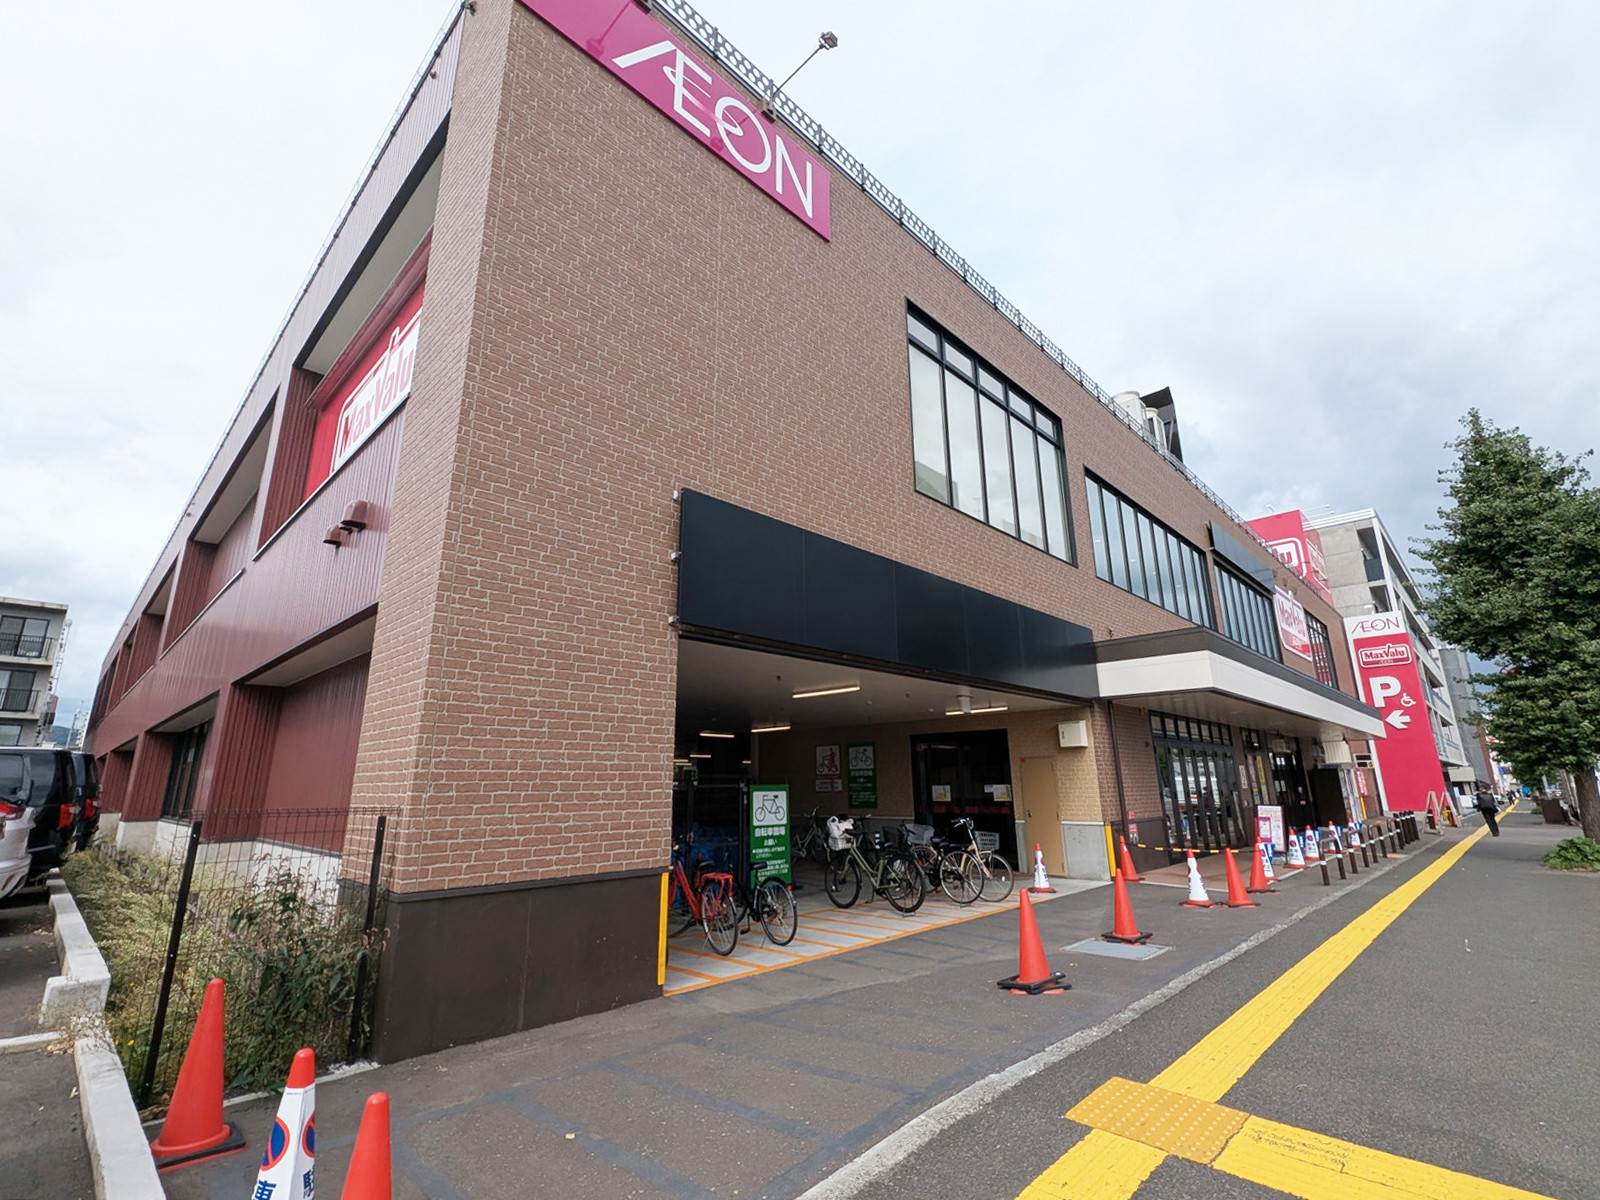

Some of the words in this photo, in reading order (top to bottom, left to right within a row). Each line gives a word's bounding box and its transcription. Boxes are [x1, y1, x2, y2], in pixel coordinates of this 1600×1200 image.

[339, 335, 415, 459] MaxValu
[1364, 645, 1406, 661] MaxValu
[1369, 676, 1401, 708] P
